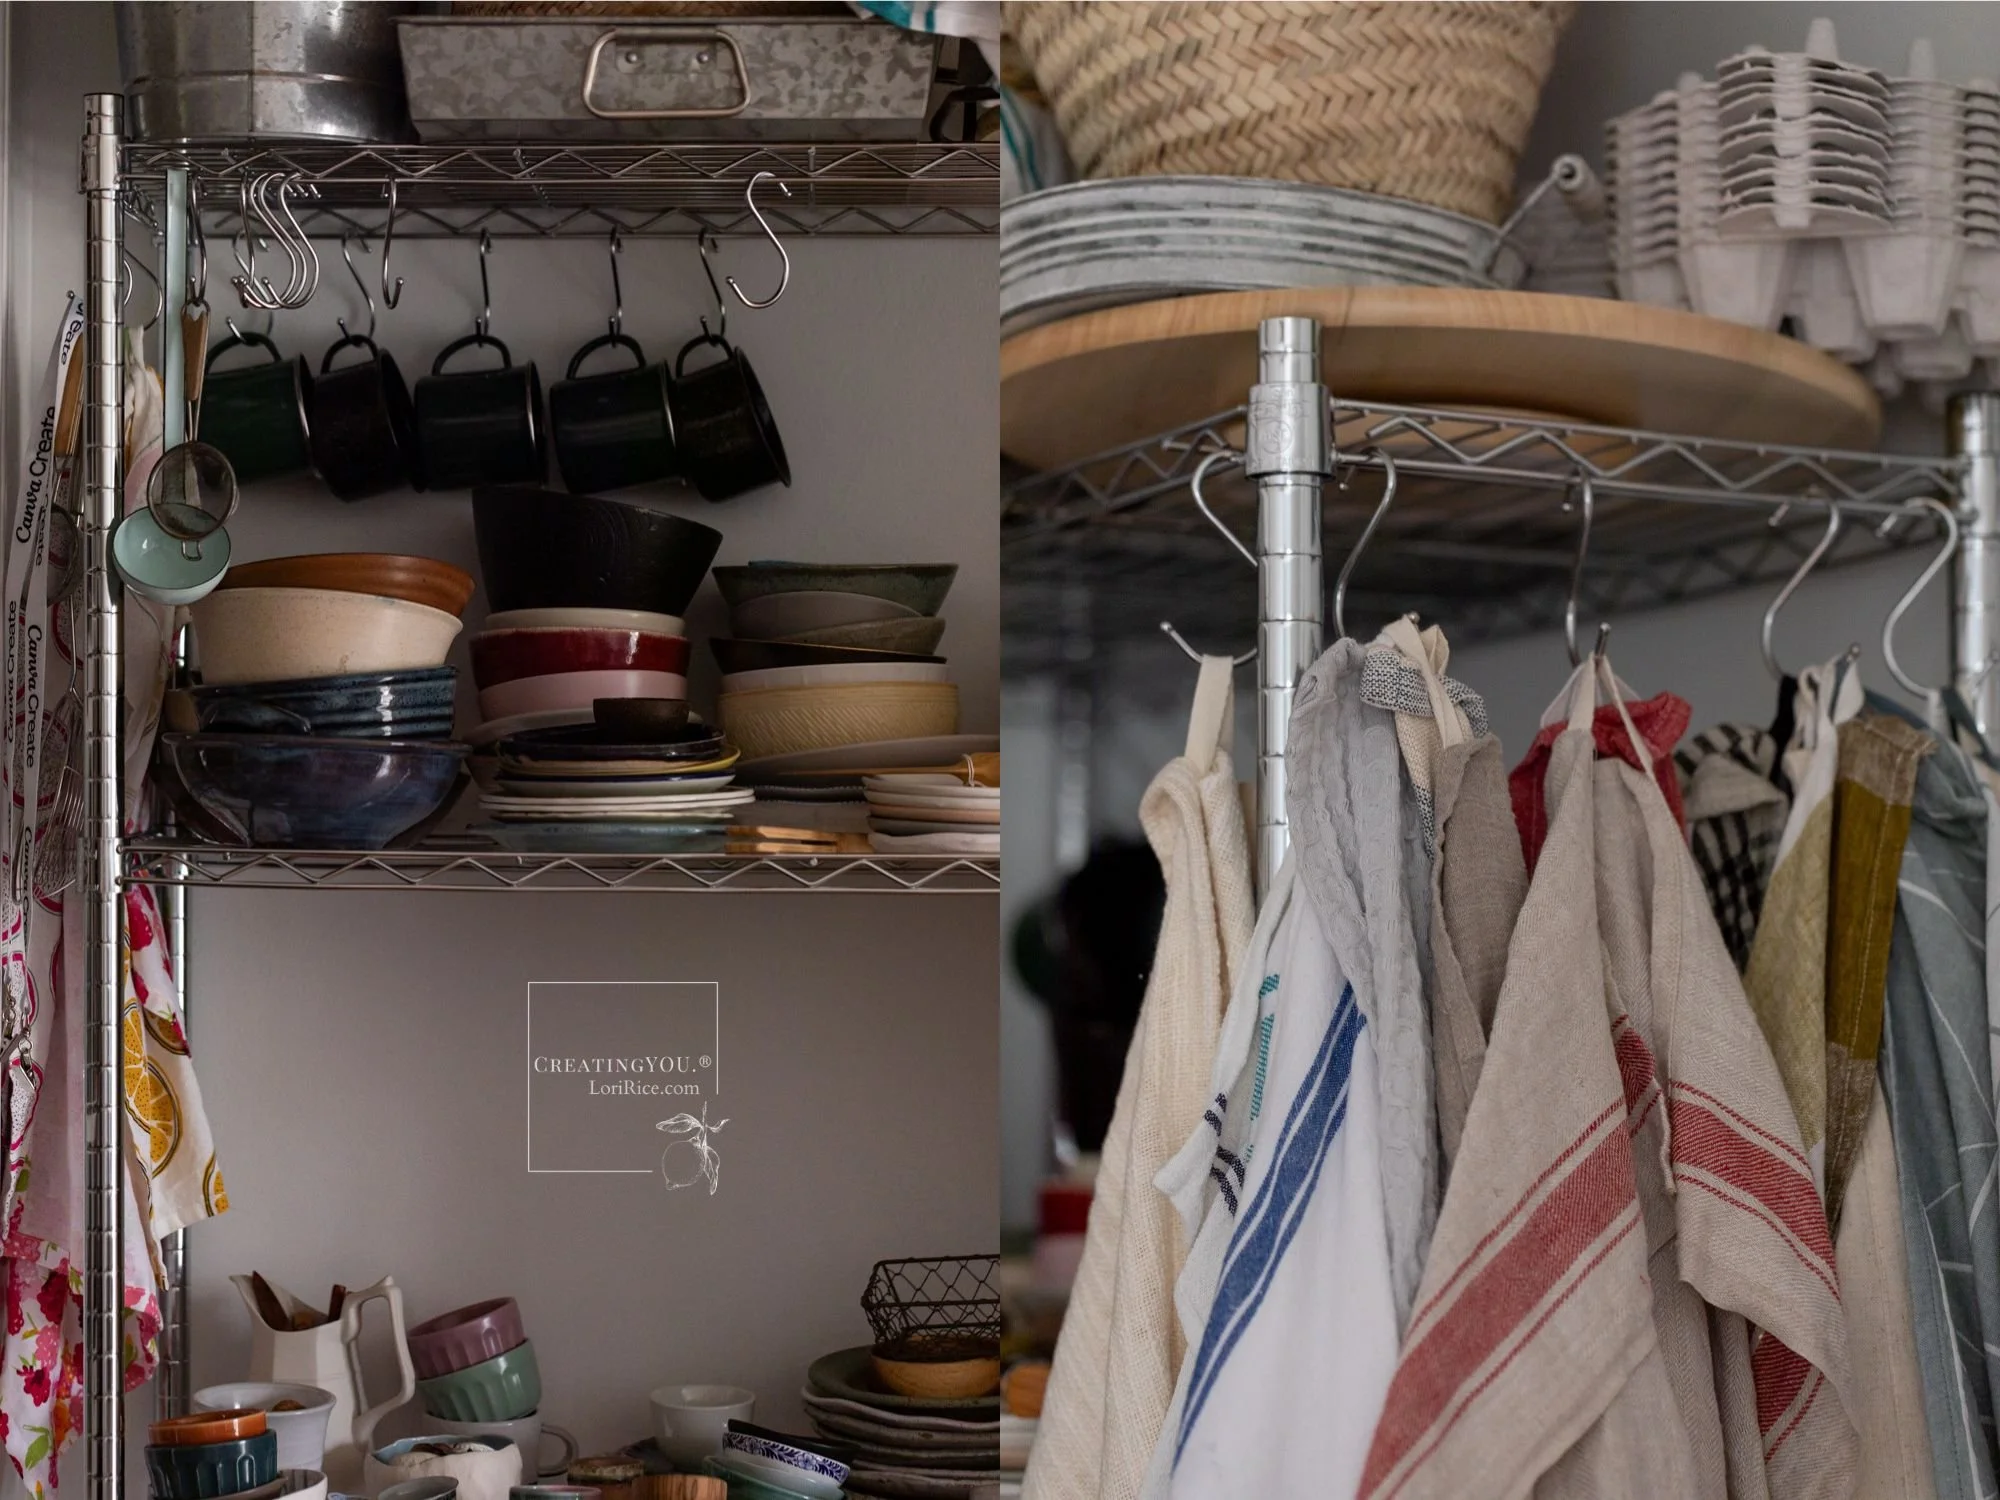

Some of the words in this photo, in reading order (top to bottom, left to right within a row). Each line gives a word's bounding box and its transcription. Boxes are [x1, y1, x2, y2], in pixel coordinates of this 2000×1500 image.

[15, 479, 42, 544] Canva
[29, 406, 55, 477] Create
[7, 600, 17, 675] Create
[27, 624, 43, 692] Canva
[7, 678, 15, 744] Canva
[26, 696, 39, 769] Create
